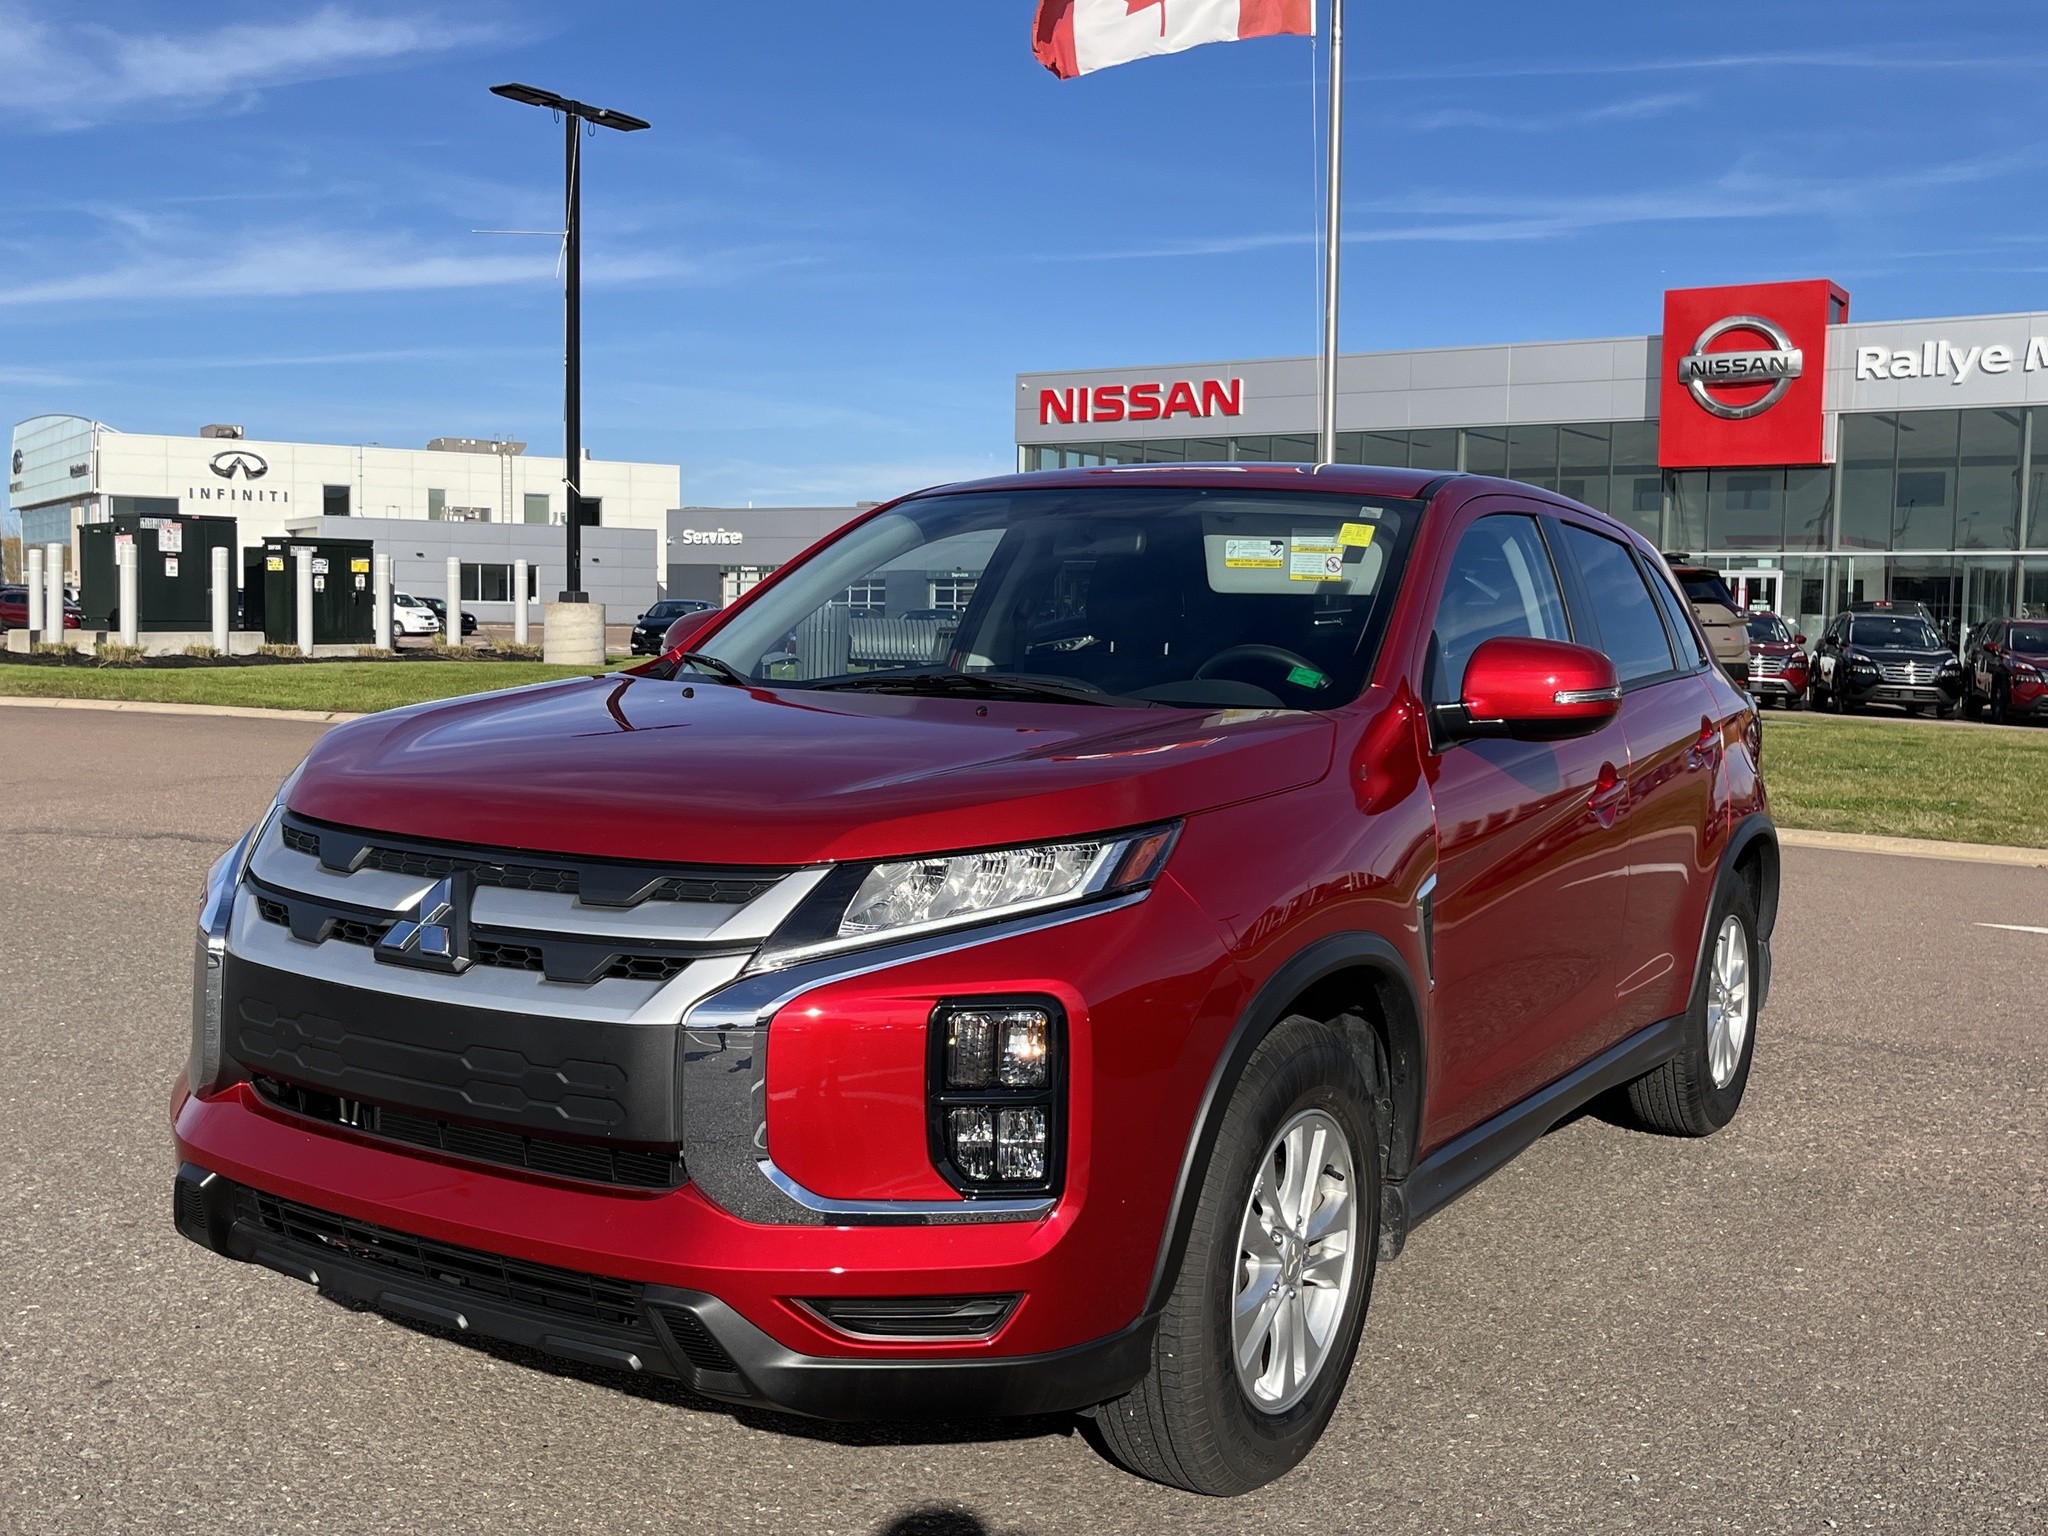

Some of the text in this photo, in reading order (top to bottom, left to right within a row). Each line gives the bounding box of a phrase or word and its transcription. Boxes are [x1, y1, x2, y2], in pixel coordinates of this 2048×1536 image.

[1690, 356, 1789, 376] NISSAN
[1856, 340, 2012, 386] Rallye
[1040, 378, 1243, 425] NISSAN
[189, 487, 288, 503] INFINITI
[682, 528, 743, 545] Service
